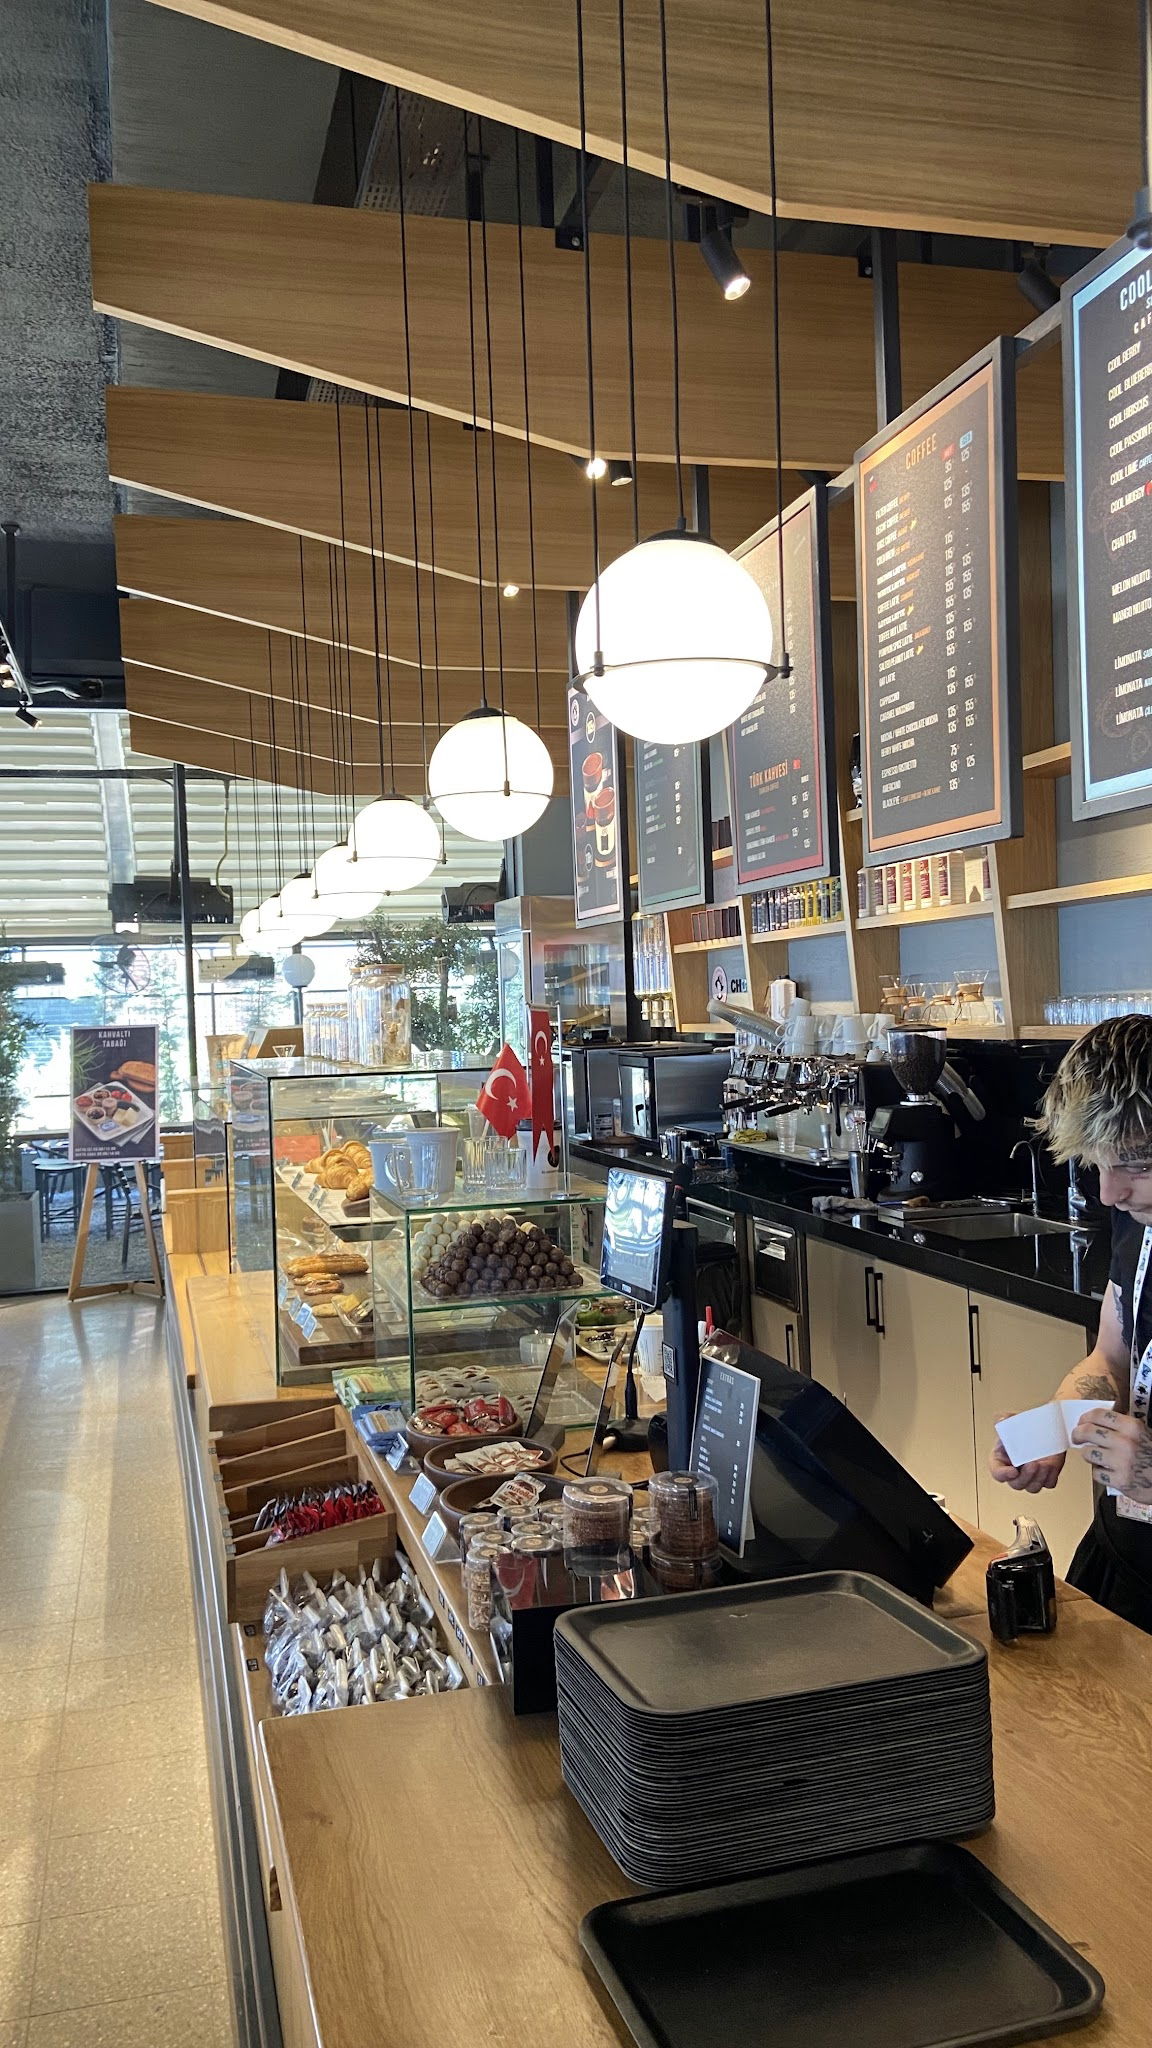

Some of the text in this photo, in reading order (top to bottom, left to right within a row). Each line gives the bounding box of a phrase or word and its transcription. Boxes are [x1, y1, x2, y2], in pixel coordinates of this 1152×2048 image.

[1108, 341, 1140, 373] COOL BERRY
[1109, 383, 1123, 401] COOL
[1109, 395, 1148, 430] COOL HIBISCUS
[906, 432, 937, 470] COFFEE
[1110, 440, 1123, 458] COOL
[1124, 424, 1147, 447] PASSION
[1111, 469, 1123, 486] COOL
[1124, 460, 1138, 479] LIME
[1111, 497, 1124, 513] COOL
[1112, 529, 1136, 551] CHAI TEA
[1112, 568, 1150, 597] MELON MOJITO
[1113, 605, 1131, 624] MANGO
[1115, 649, 1141, 670] LİMONATA
[1115, 678, 1142, 698] LİMONATA
[1116, 706, 1143, 726] LİMONATA
[749, 771, 764, 789] TÜRK
[764, 759, 788, 782] KAHVESİ
[98, 1030, 131, 1039] KAHVALTI
[102, 1038, 127, 1048] TABAĞI
